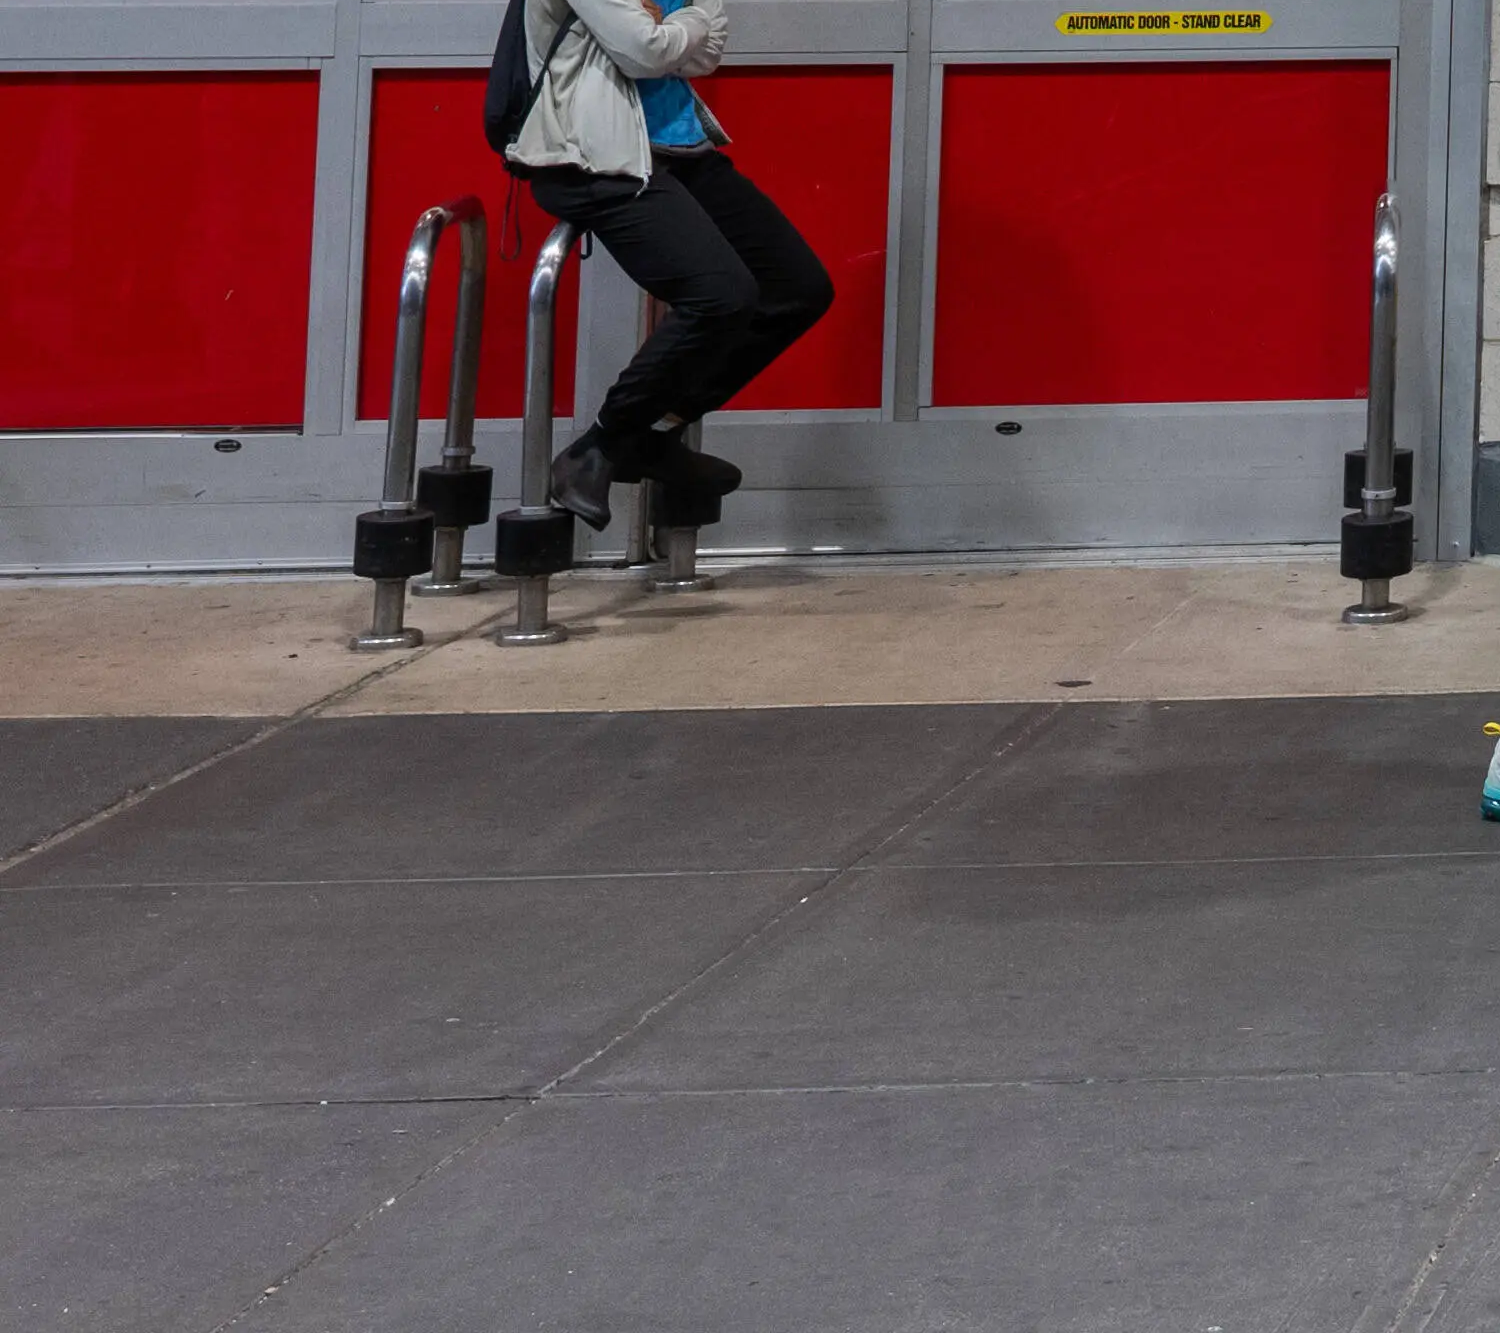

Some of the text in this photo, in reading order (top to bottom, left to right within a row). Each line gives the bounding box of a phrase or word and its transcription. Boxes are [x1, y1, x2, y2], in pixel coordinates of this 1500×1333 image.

[1067, 15, 1134, 30] AUTOMATIC
[1138, 15, 1170, 29] DOOR
[1182, 14, 1220, 29] STAND
[1223, 14, 1261, 29] CLEAR
